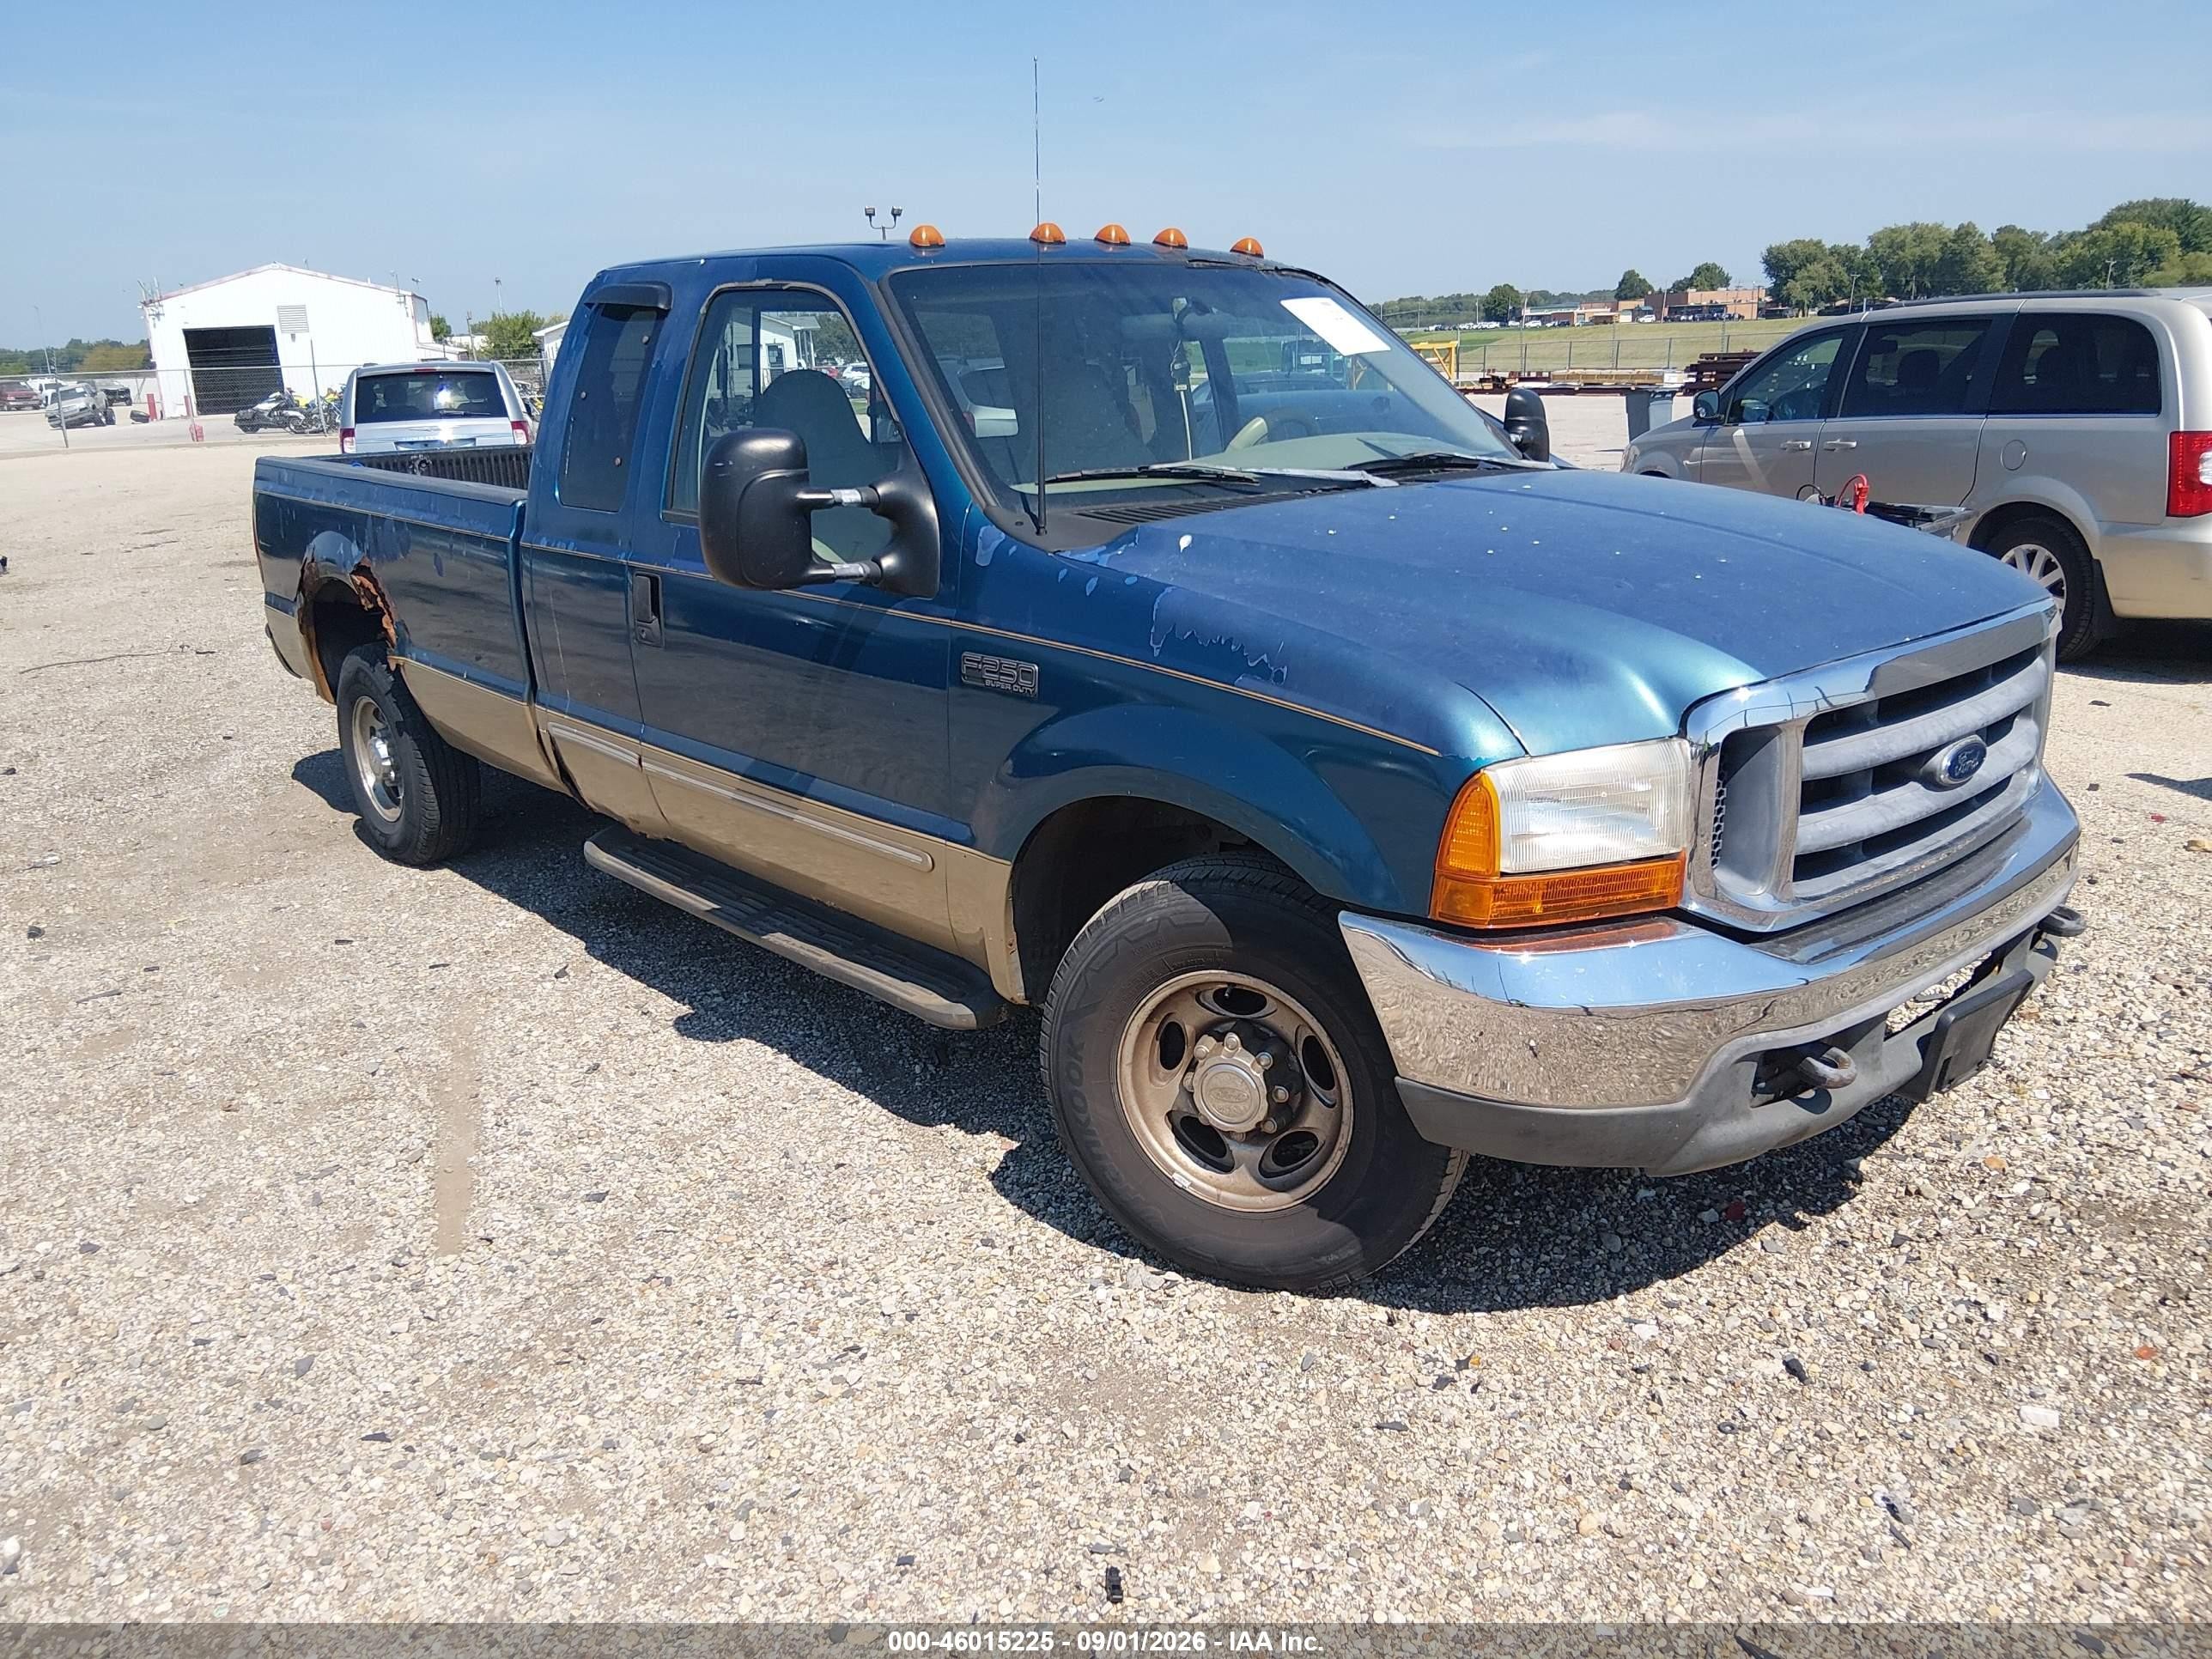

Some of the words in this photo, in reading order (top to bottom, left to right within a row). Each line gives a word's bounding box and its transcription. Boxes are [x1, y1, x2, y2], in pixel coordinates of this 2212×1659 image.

[962, 653, 1036, 688] F-250
[985, 679, 1012, 690] SUPER
[1012, 684, 1036, 695] DUTY
[1954, 749, 1980, 777] Ford
